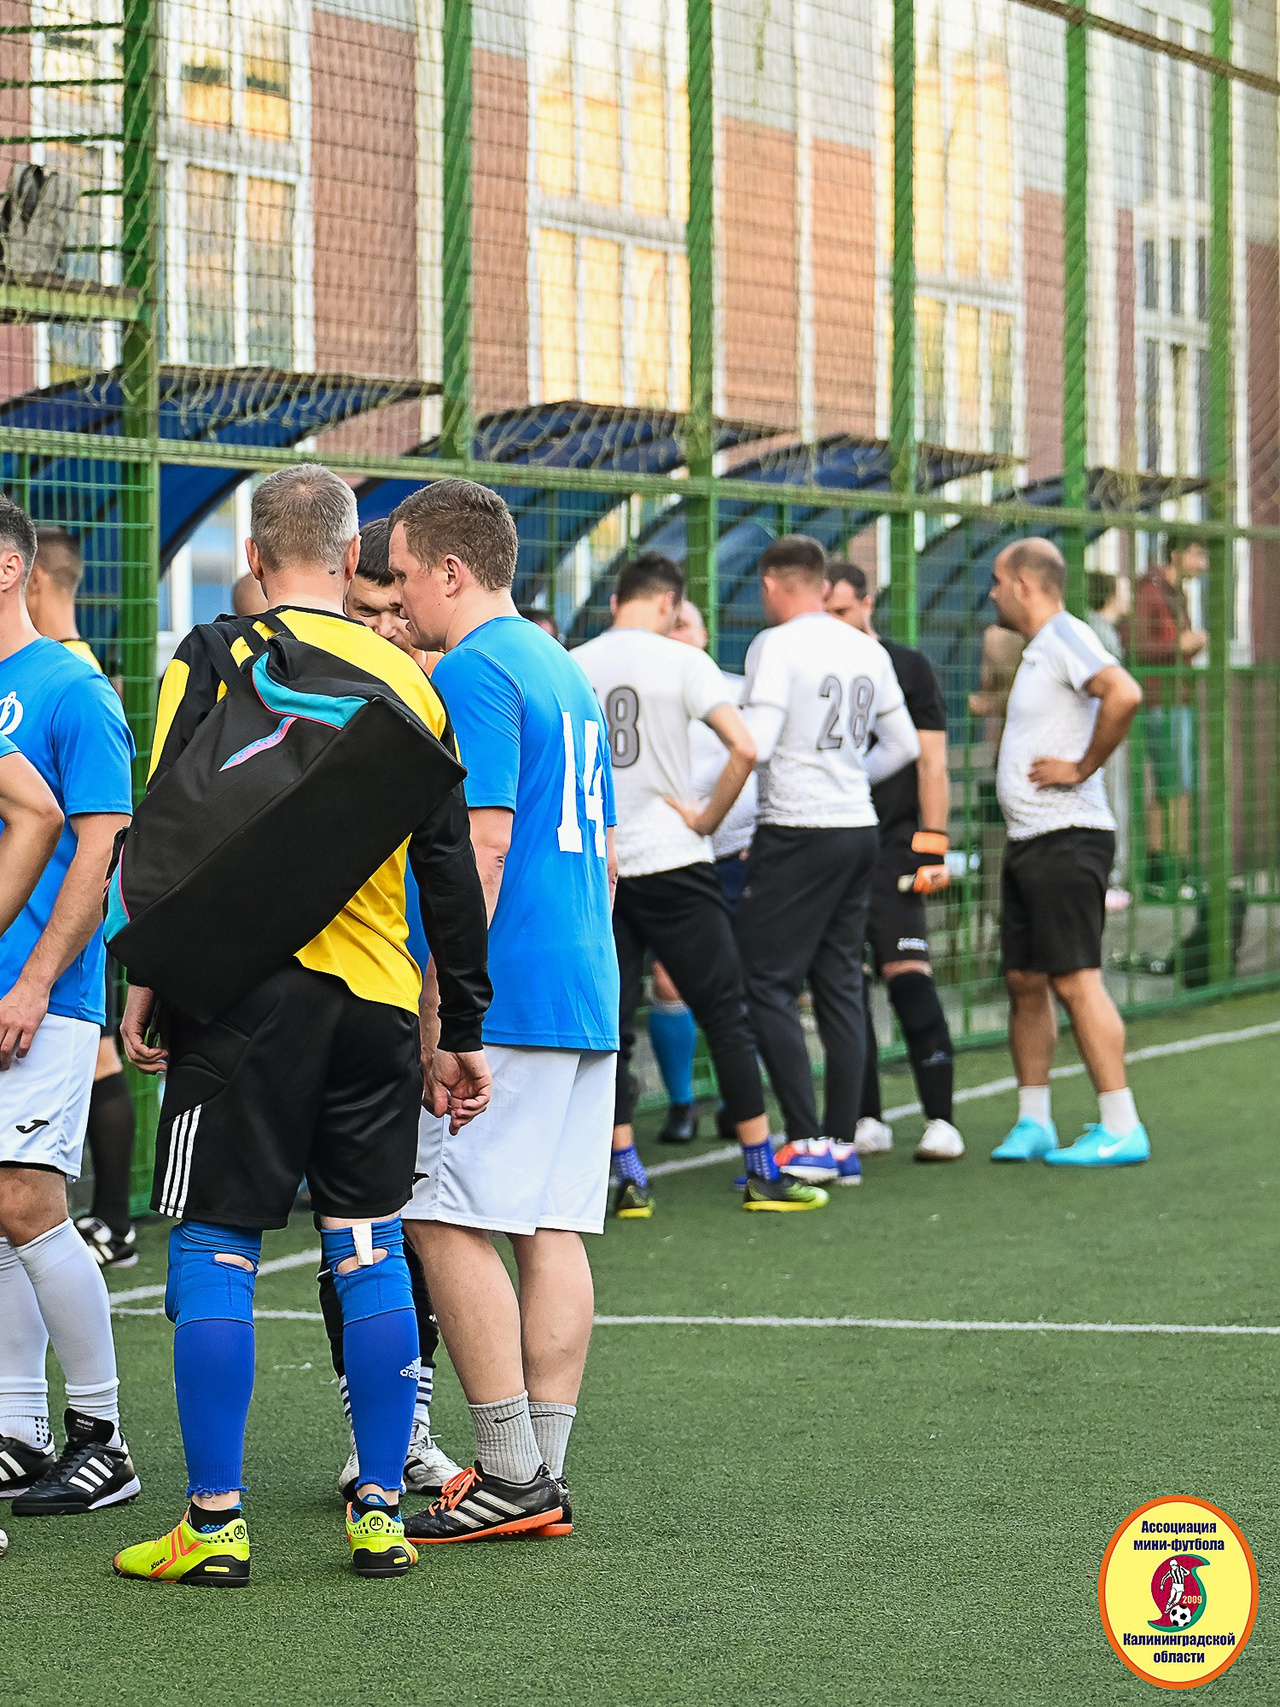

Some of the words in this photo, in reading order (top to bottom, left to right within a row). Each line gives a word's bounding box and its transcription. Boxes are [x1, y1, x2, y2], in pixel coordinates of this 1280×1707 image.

[605, 685, 640, 768] 8
[816, 675, 875, 750] 28
[556, 711, 607, 858] 14
